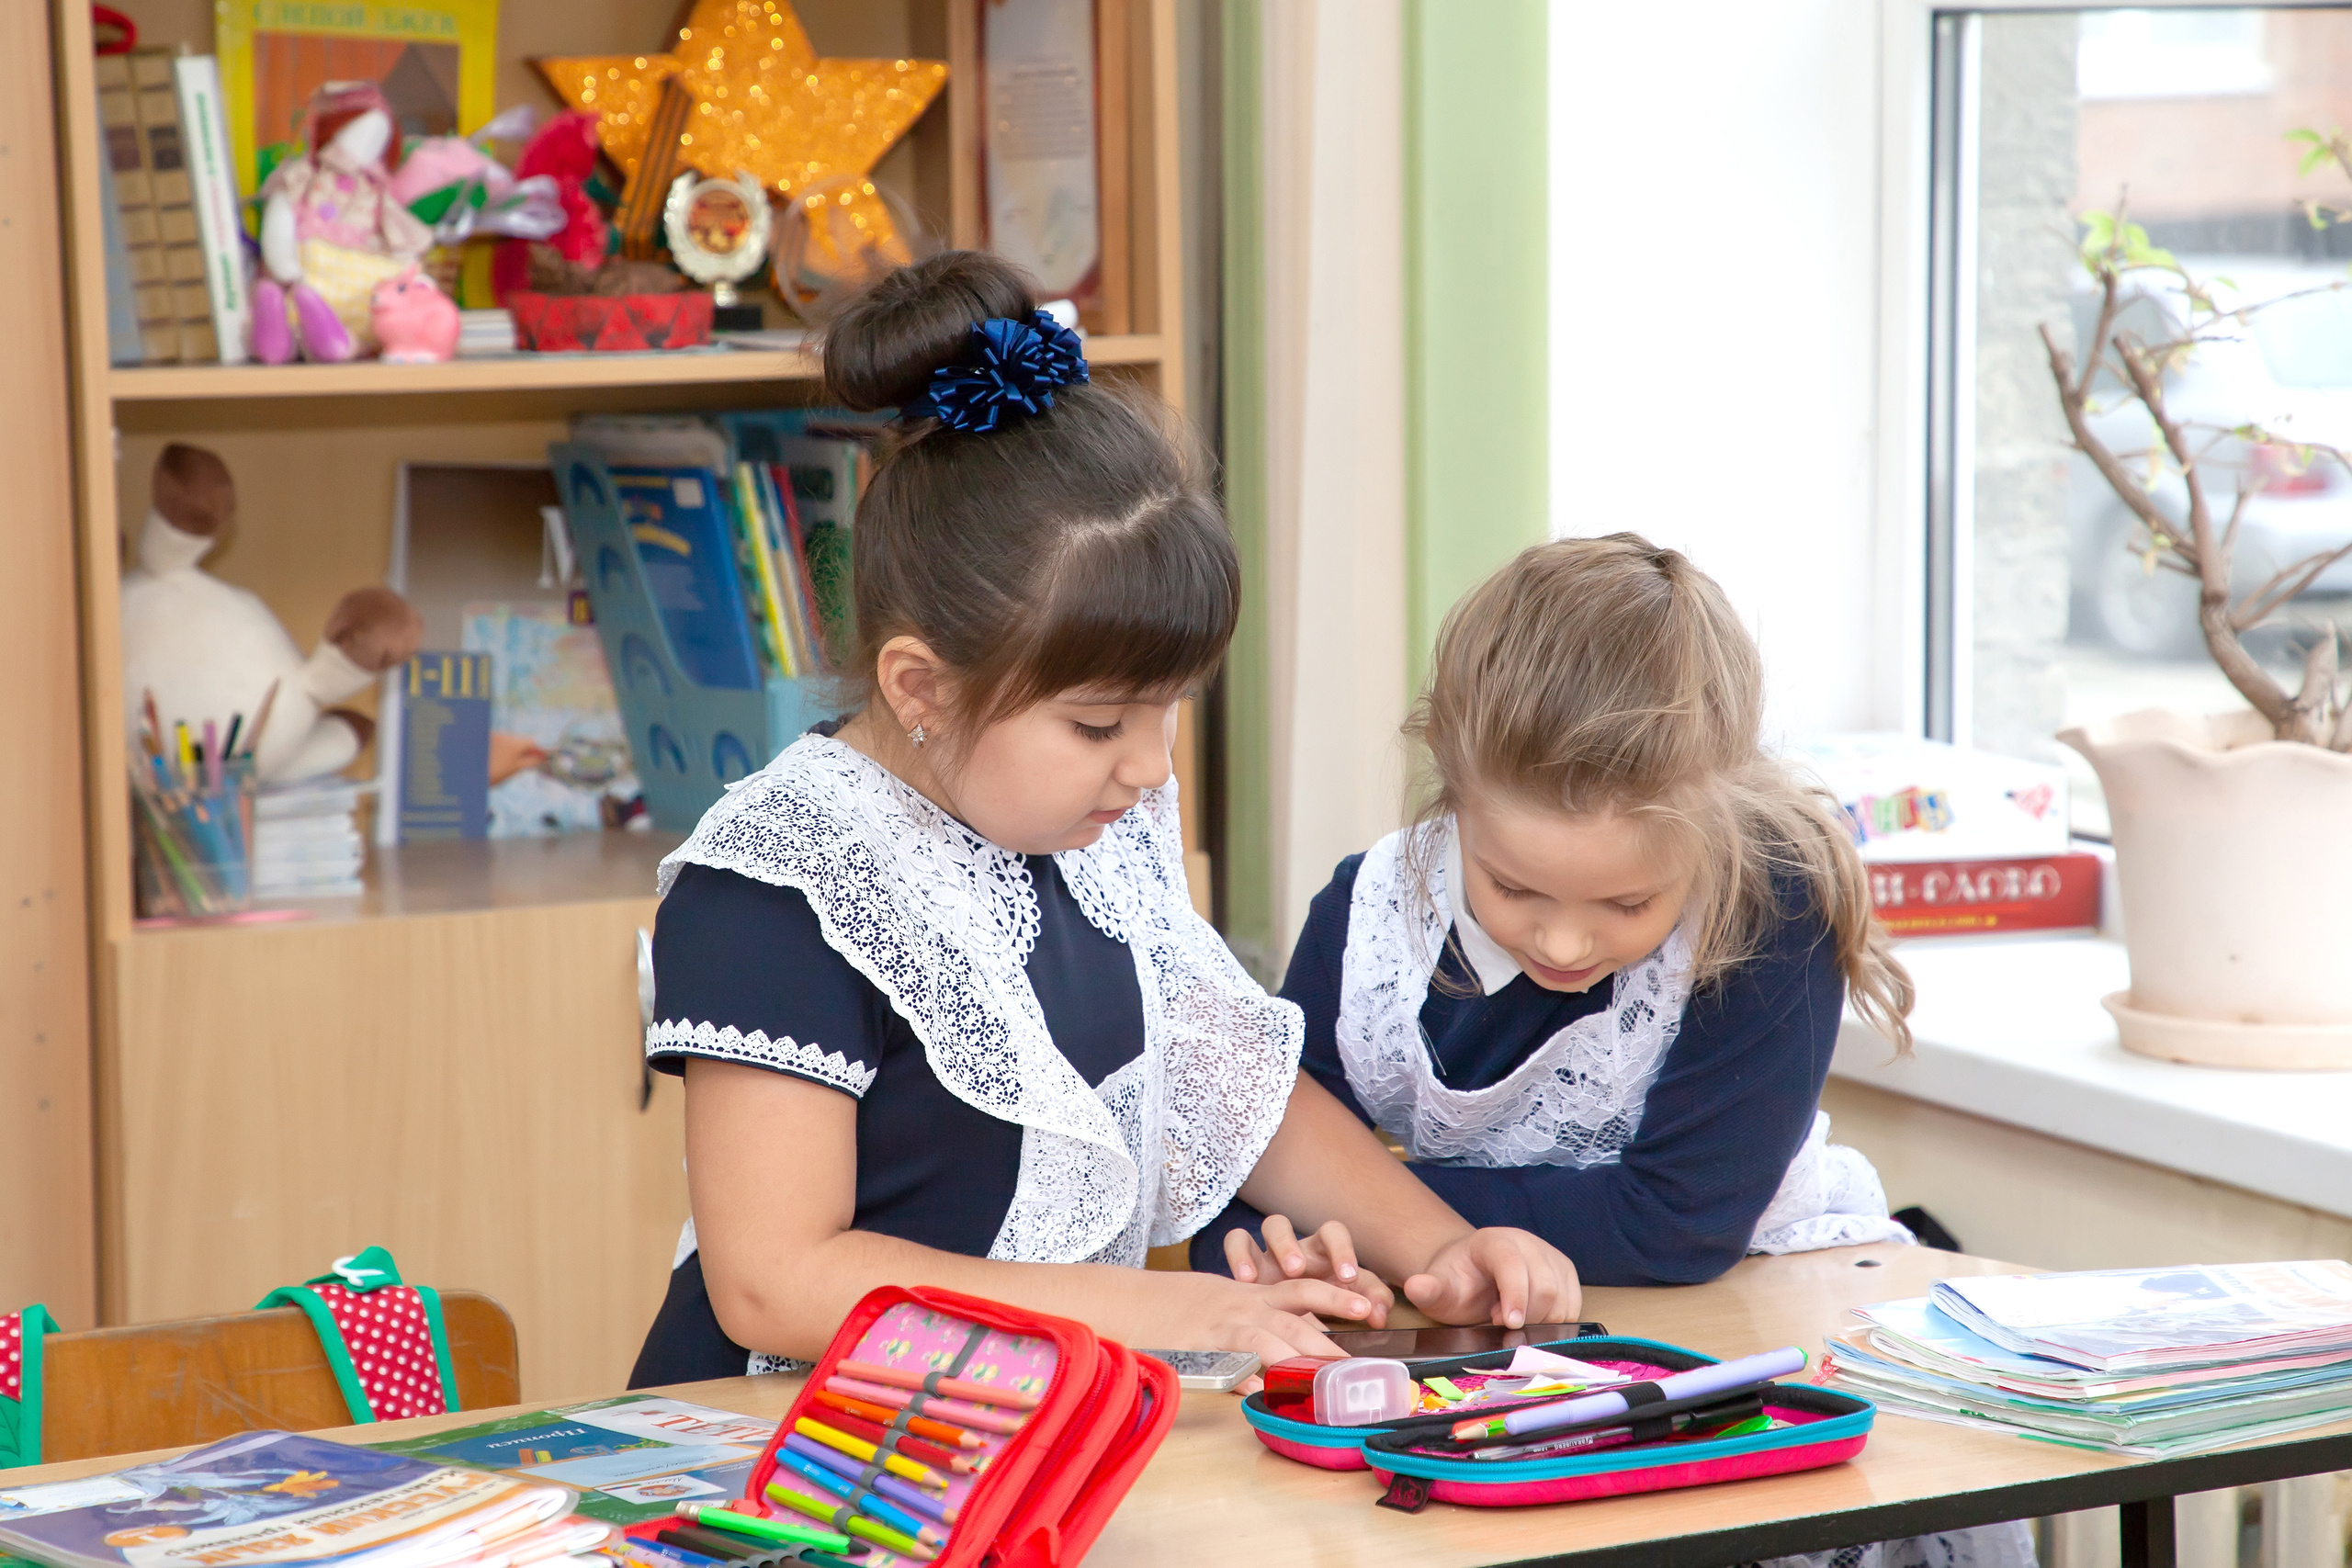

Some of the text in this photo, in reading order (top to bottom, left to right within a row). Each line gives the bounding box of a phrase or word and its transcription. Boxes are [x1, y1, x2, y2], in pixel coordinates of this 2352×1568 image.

[486, 1427, 588, 1450] Прописи
[650, 1414, 775, 1440] ТЕТР
[1554, 1438, 1587, 1450] BRAUBERG
[308, 1472, 494, 1536] РУССКИЙ
[185, 1533, 314, 1564] ЯЗЫК
